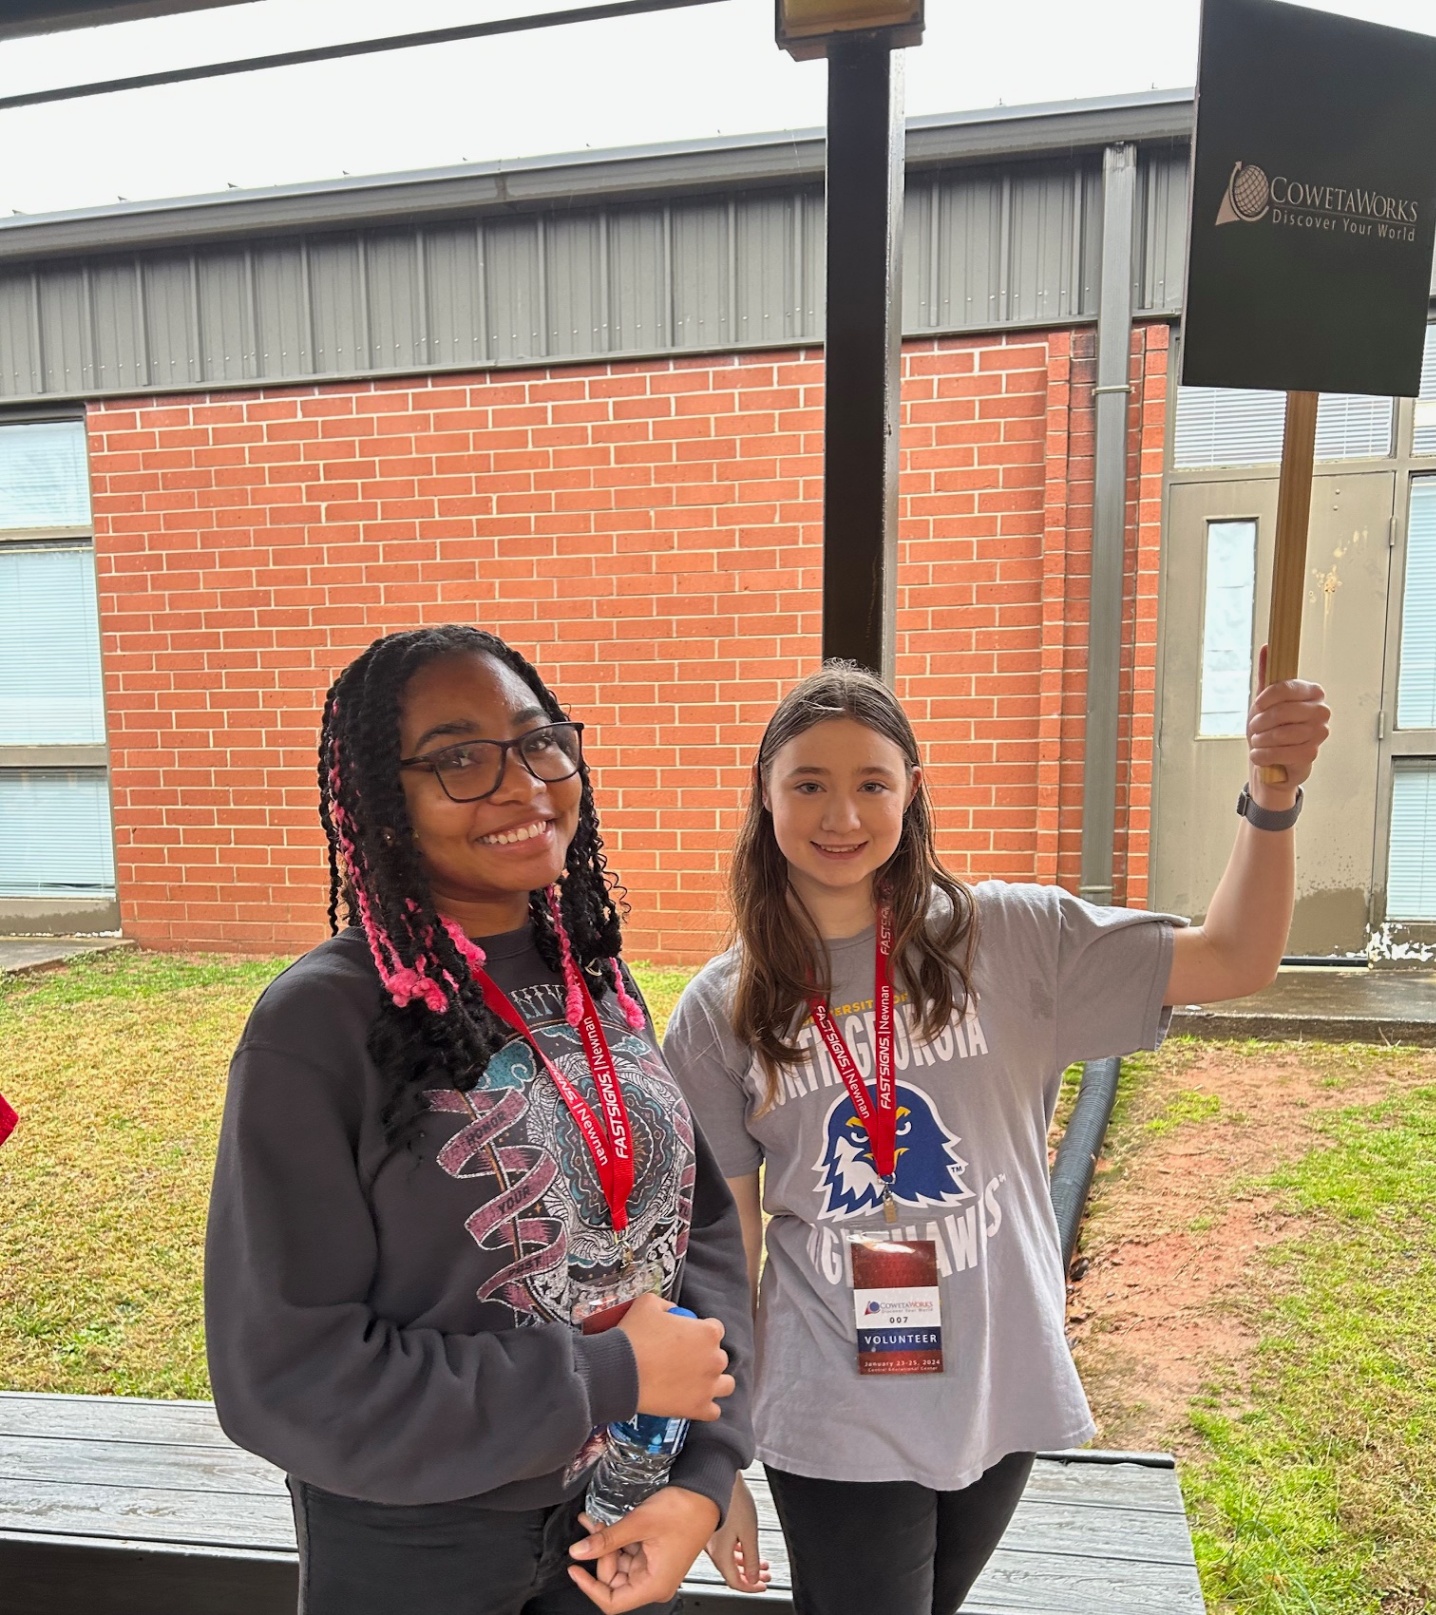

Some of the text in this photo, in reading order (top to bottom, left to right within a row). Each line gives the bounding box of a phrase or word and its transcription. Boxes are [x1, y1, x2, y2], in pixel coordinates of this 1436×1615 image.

[1273, 208, 1415, 242] Discover Your World
[880, 985, 890, 1029] Newnan
[584, 1016, 607, 1063] Newnan
[846, 1071, 870, 1119] Newnan
[577, 1108, 608, 1166] Newnan
[951, 1166, 963, 1174] TM
[497, 1185, 530, 1214] YOUR
[889, 1316, 908, 1324] 007
[864, 1334, 938, 1345] VOLUNTEER
